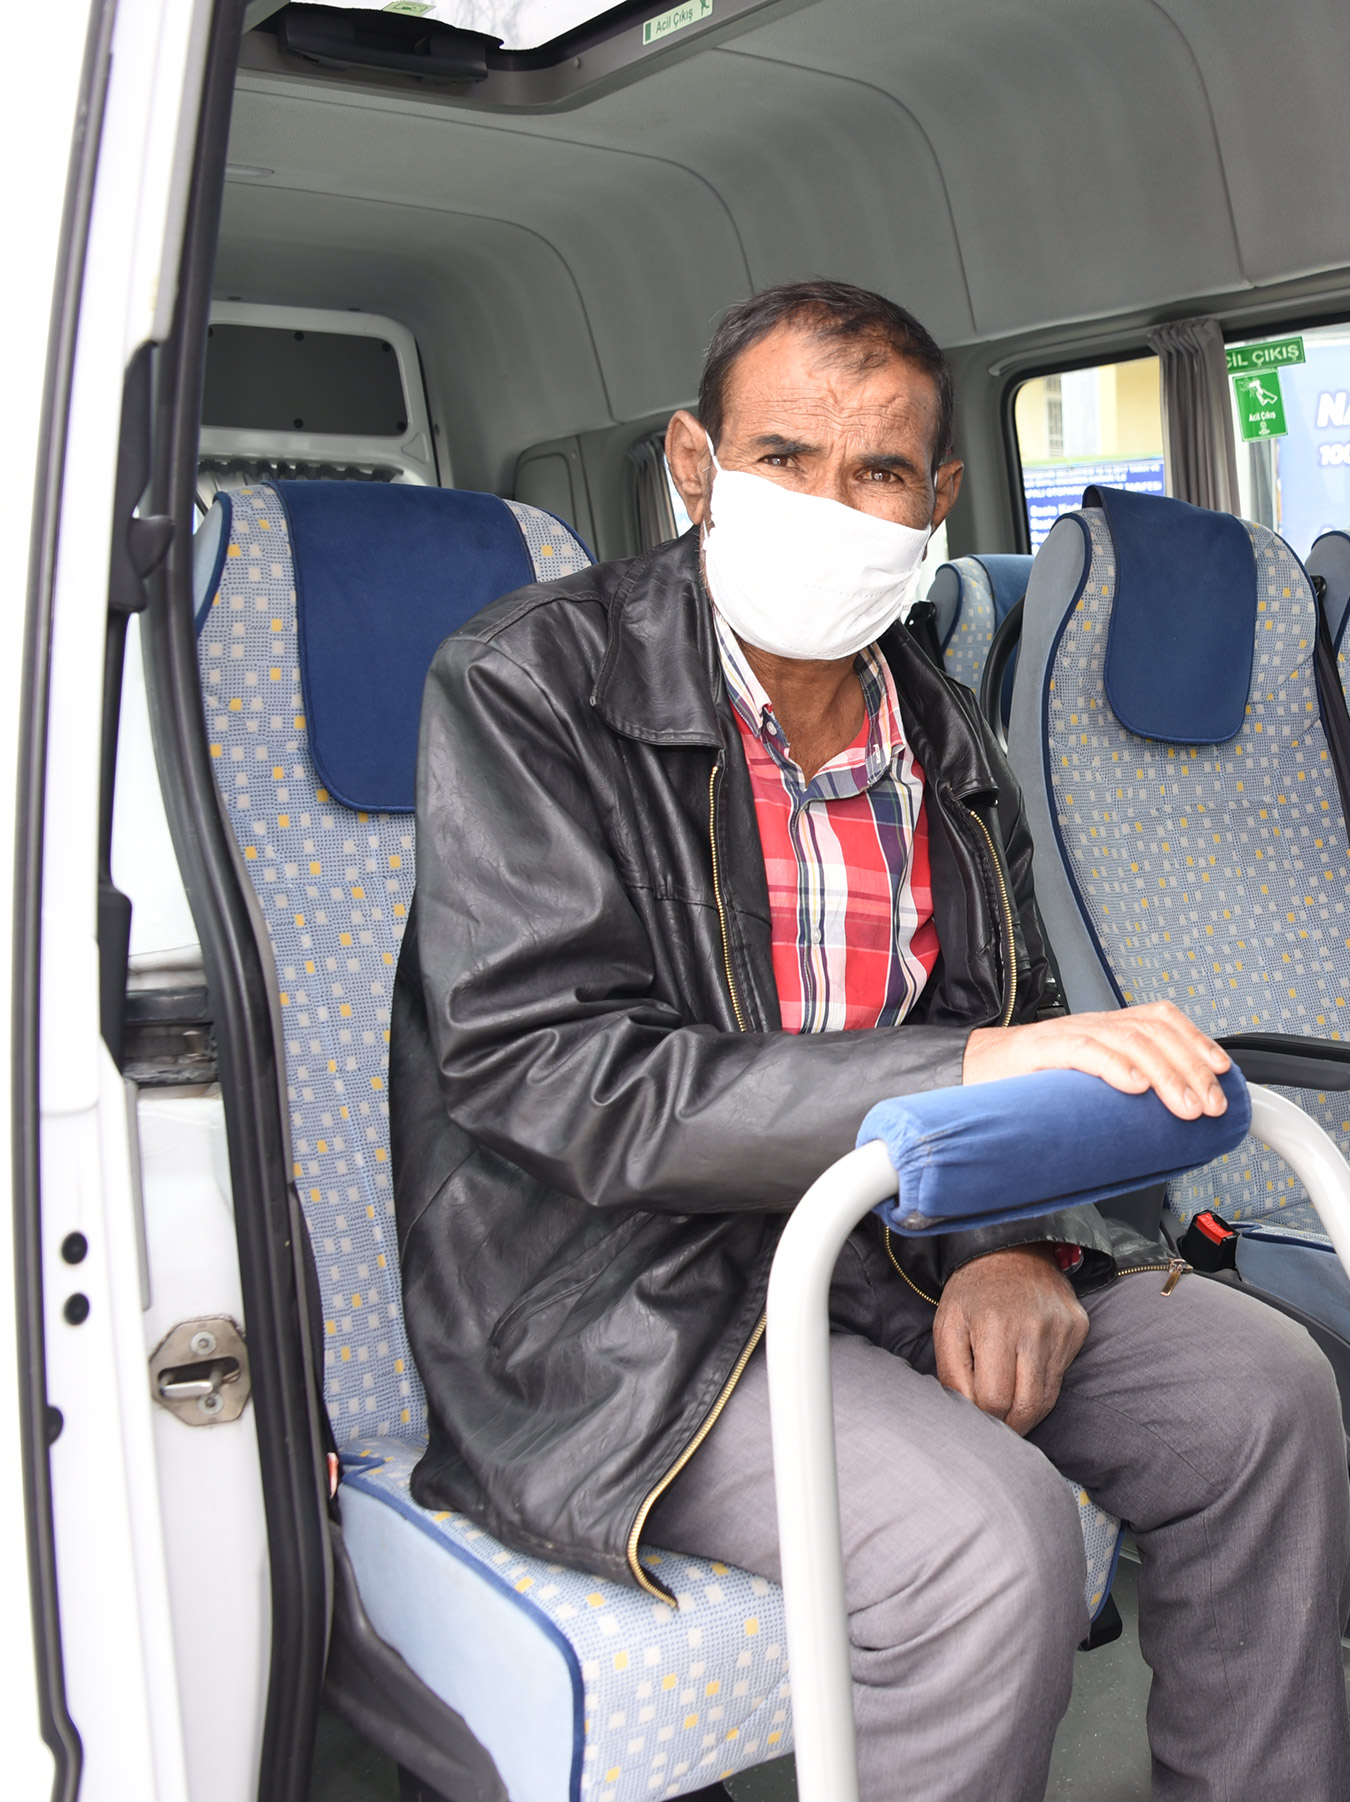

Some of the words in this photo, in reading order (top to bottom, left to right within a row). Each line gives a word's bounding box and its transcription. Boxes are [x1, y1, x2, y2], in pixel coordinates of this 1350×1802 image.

[656, 15, 672, 34] Acil
[673, 8, 693, 29] Çıkış
[1251, 344, 1299, 367] ÇIKIŞ
